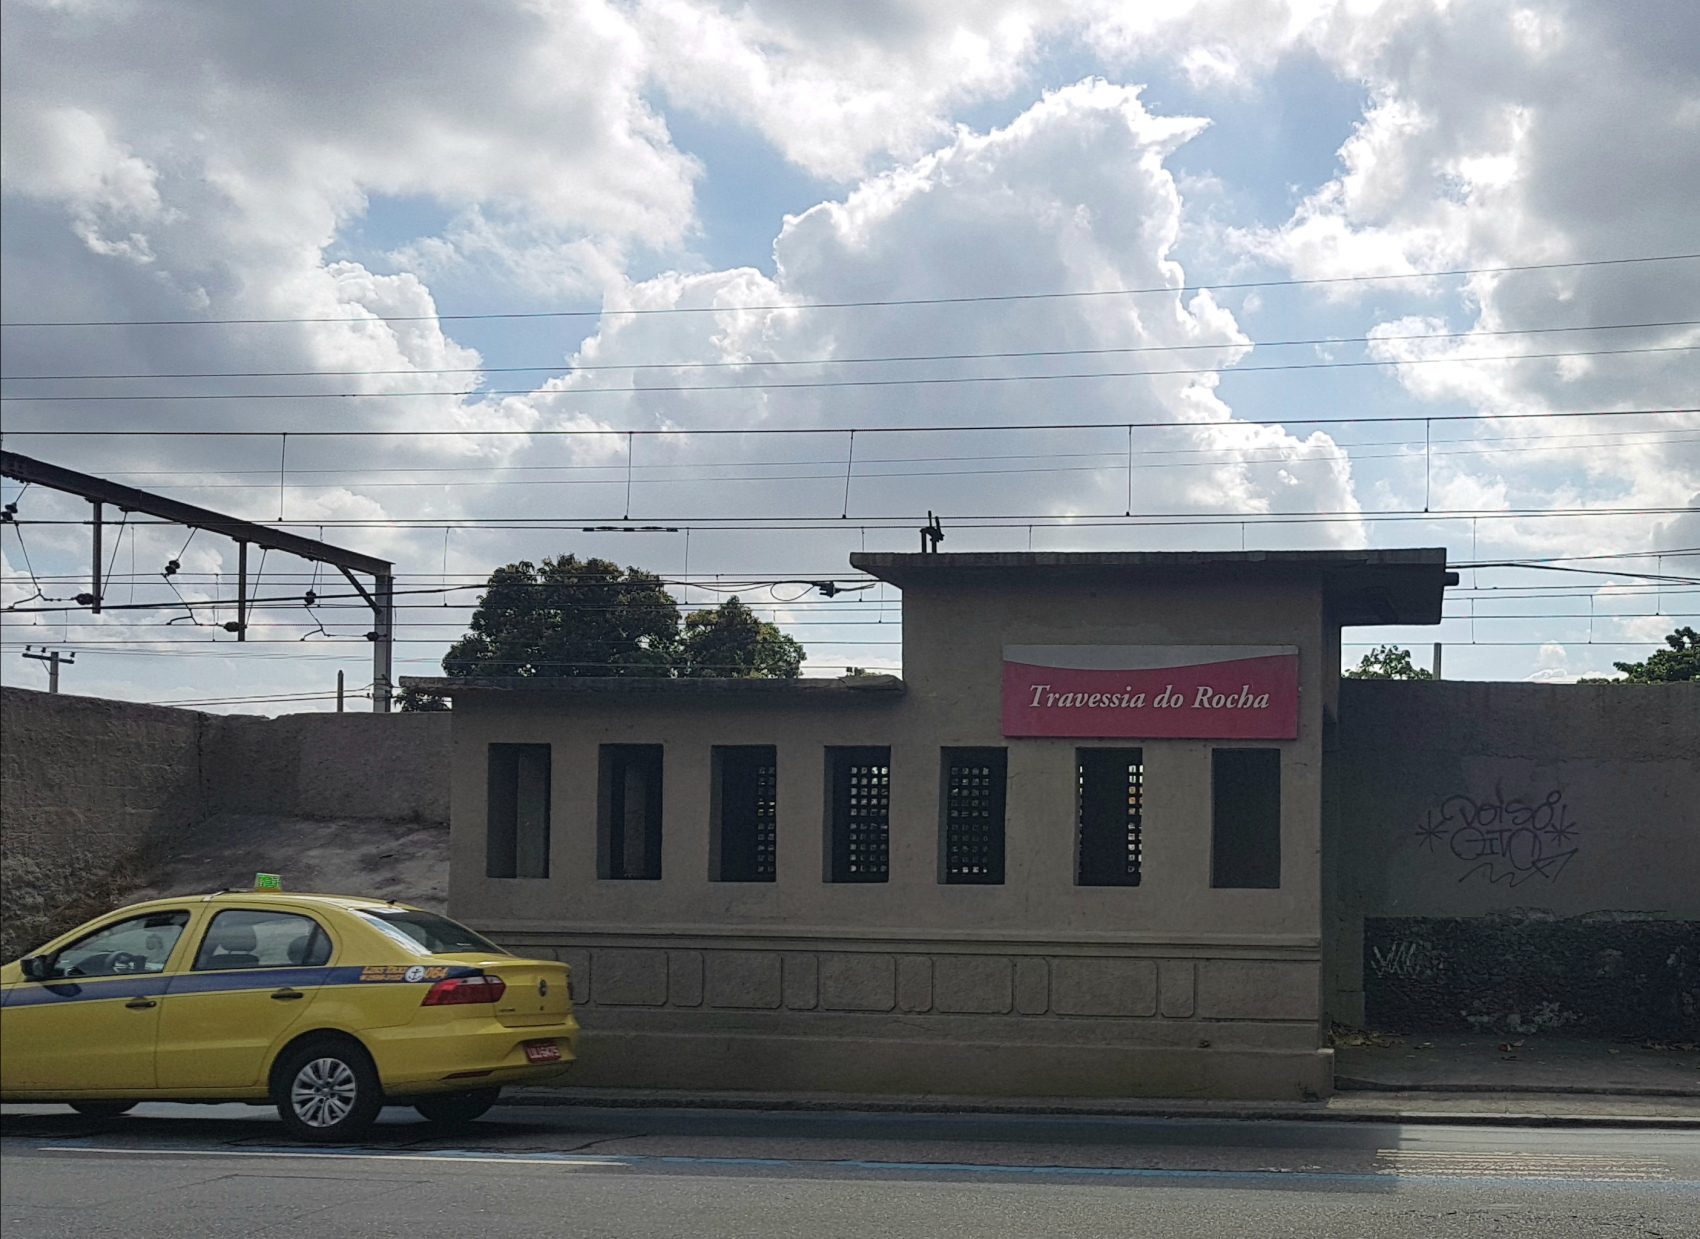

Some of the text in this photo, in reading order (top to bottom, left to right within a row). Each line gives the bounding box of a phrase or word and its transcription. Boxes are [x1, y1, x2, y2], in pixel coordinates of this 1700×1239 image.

[1029, 684, 1270, 708] Travessia do Rocha
